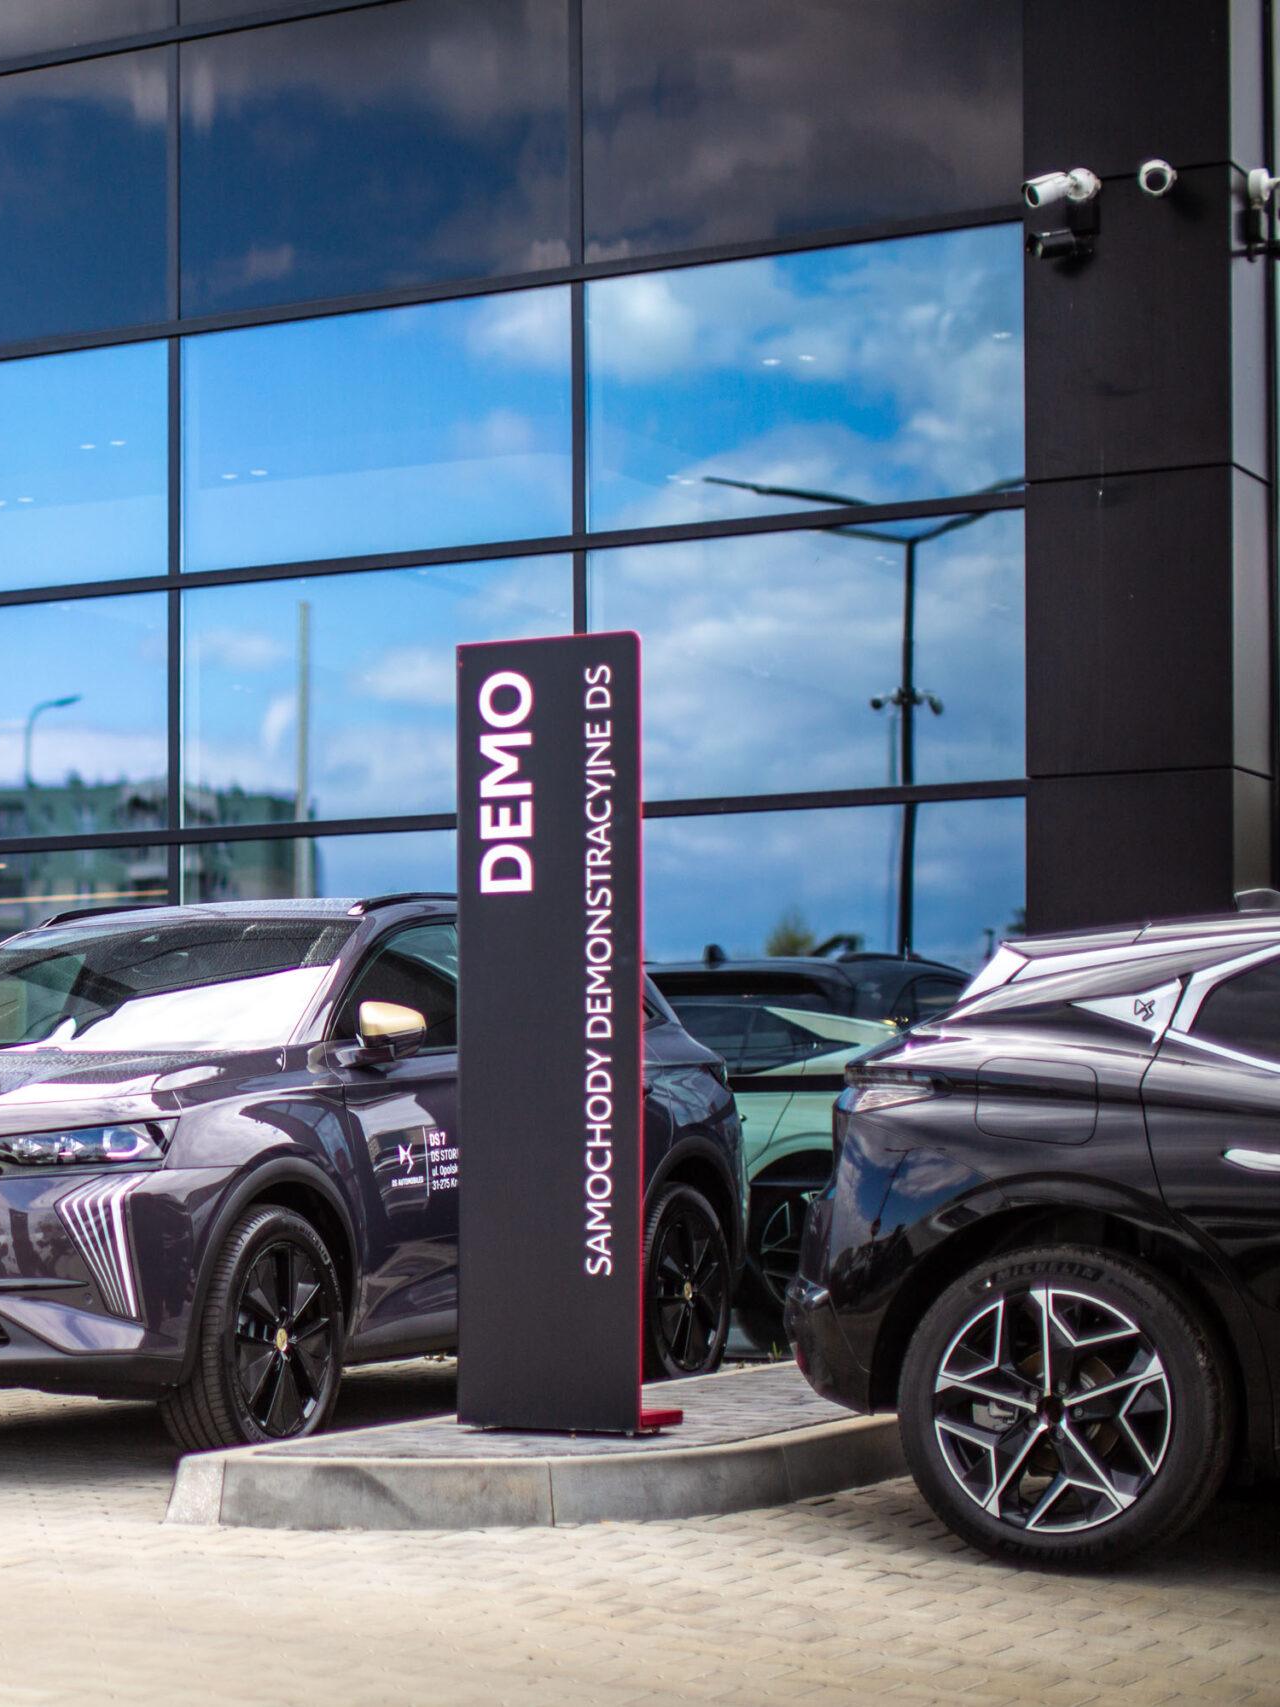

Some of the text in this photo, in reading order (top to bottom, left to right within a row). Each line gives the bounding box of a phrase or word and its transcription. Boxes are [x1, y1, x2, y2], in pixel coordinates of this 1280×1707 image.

[478, 671, 534, 894] DEMO
[585, 664, 616, 1277] SAMOCHODY DEMONSTRACYJNE DS
[429, 1132, 446, 1147] DS 7
[430, 1150, 440, 1162] DS
